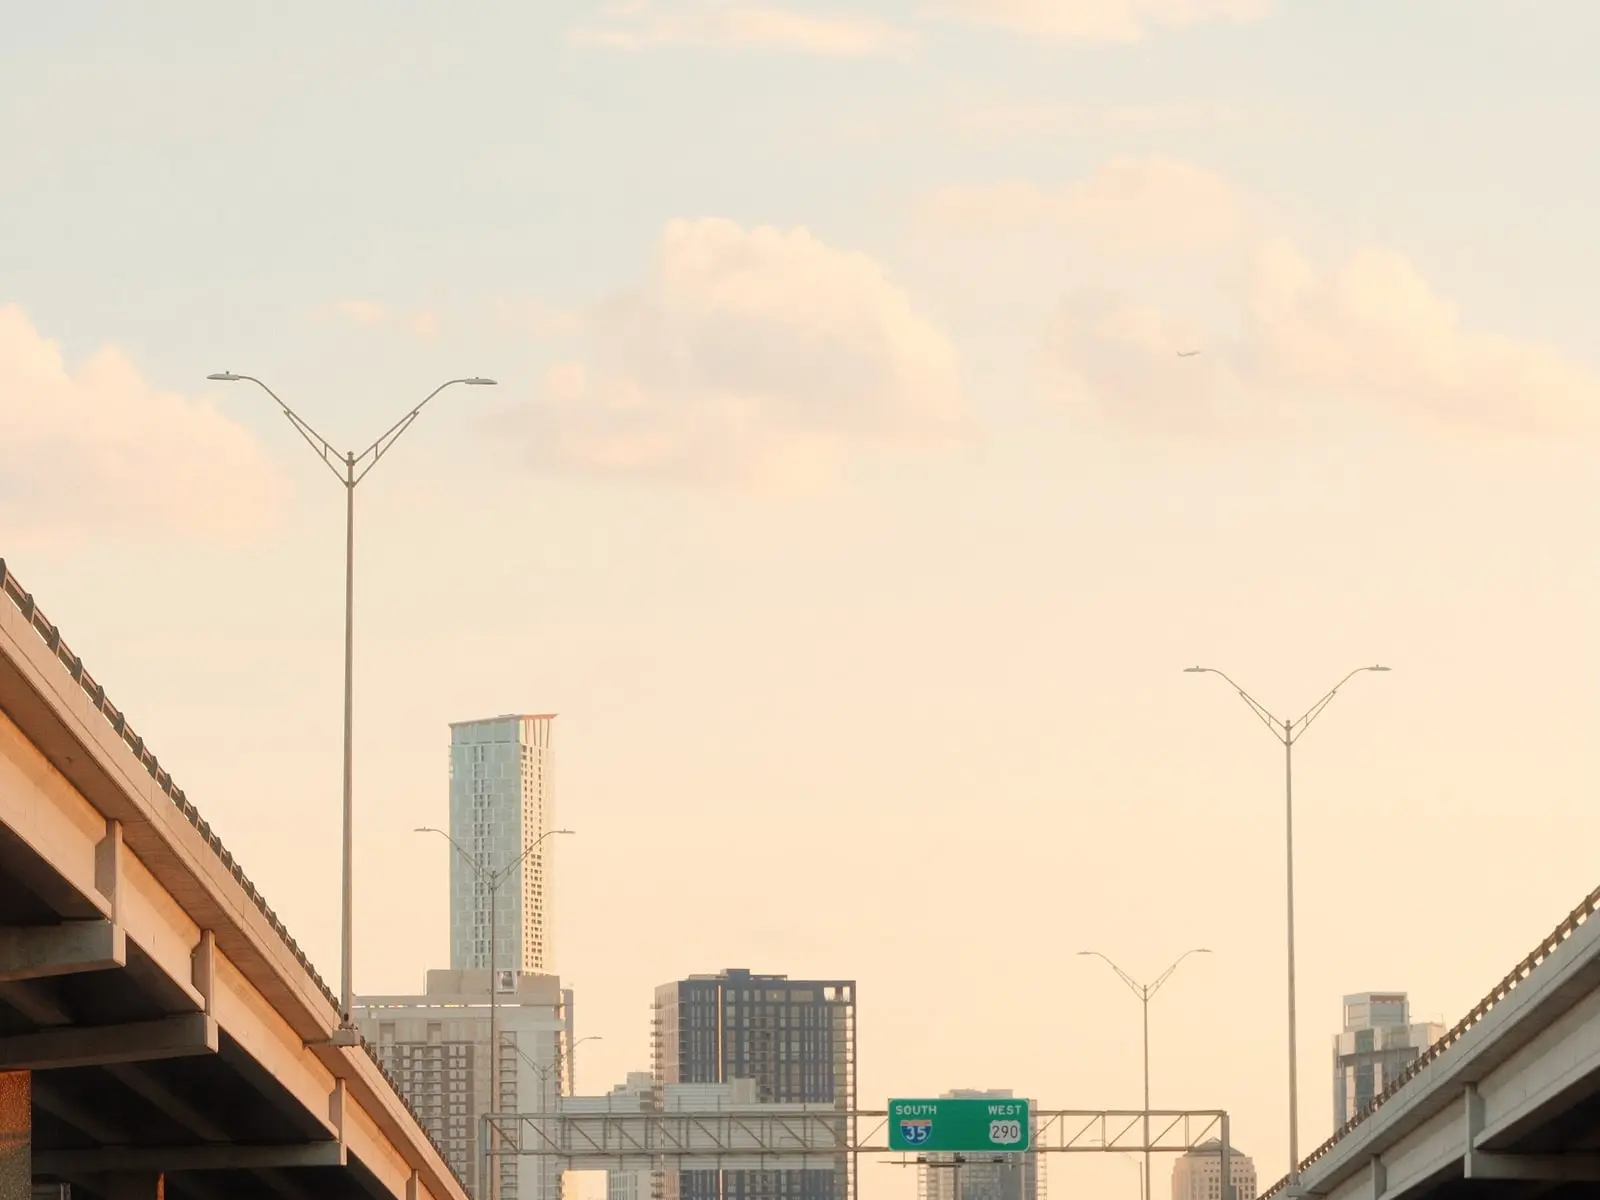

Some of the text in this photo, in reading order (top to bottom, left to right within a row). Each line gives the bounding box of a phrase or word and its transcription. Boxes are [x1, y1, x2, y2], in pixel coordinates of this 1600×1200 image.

[895, 1105, 937, 1115] SOUTH
[988, 1105, 1022, 1115] WEST
[906, 1126, 927, 1140] 35
[992, 1125, 1018, 1139] 290
